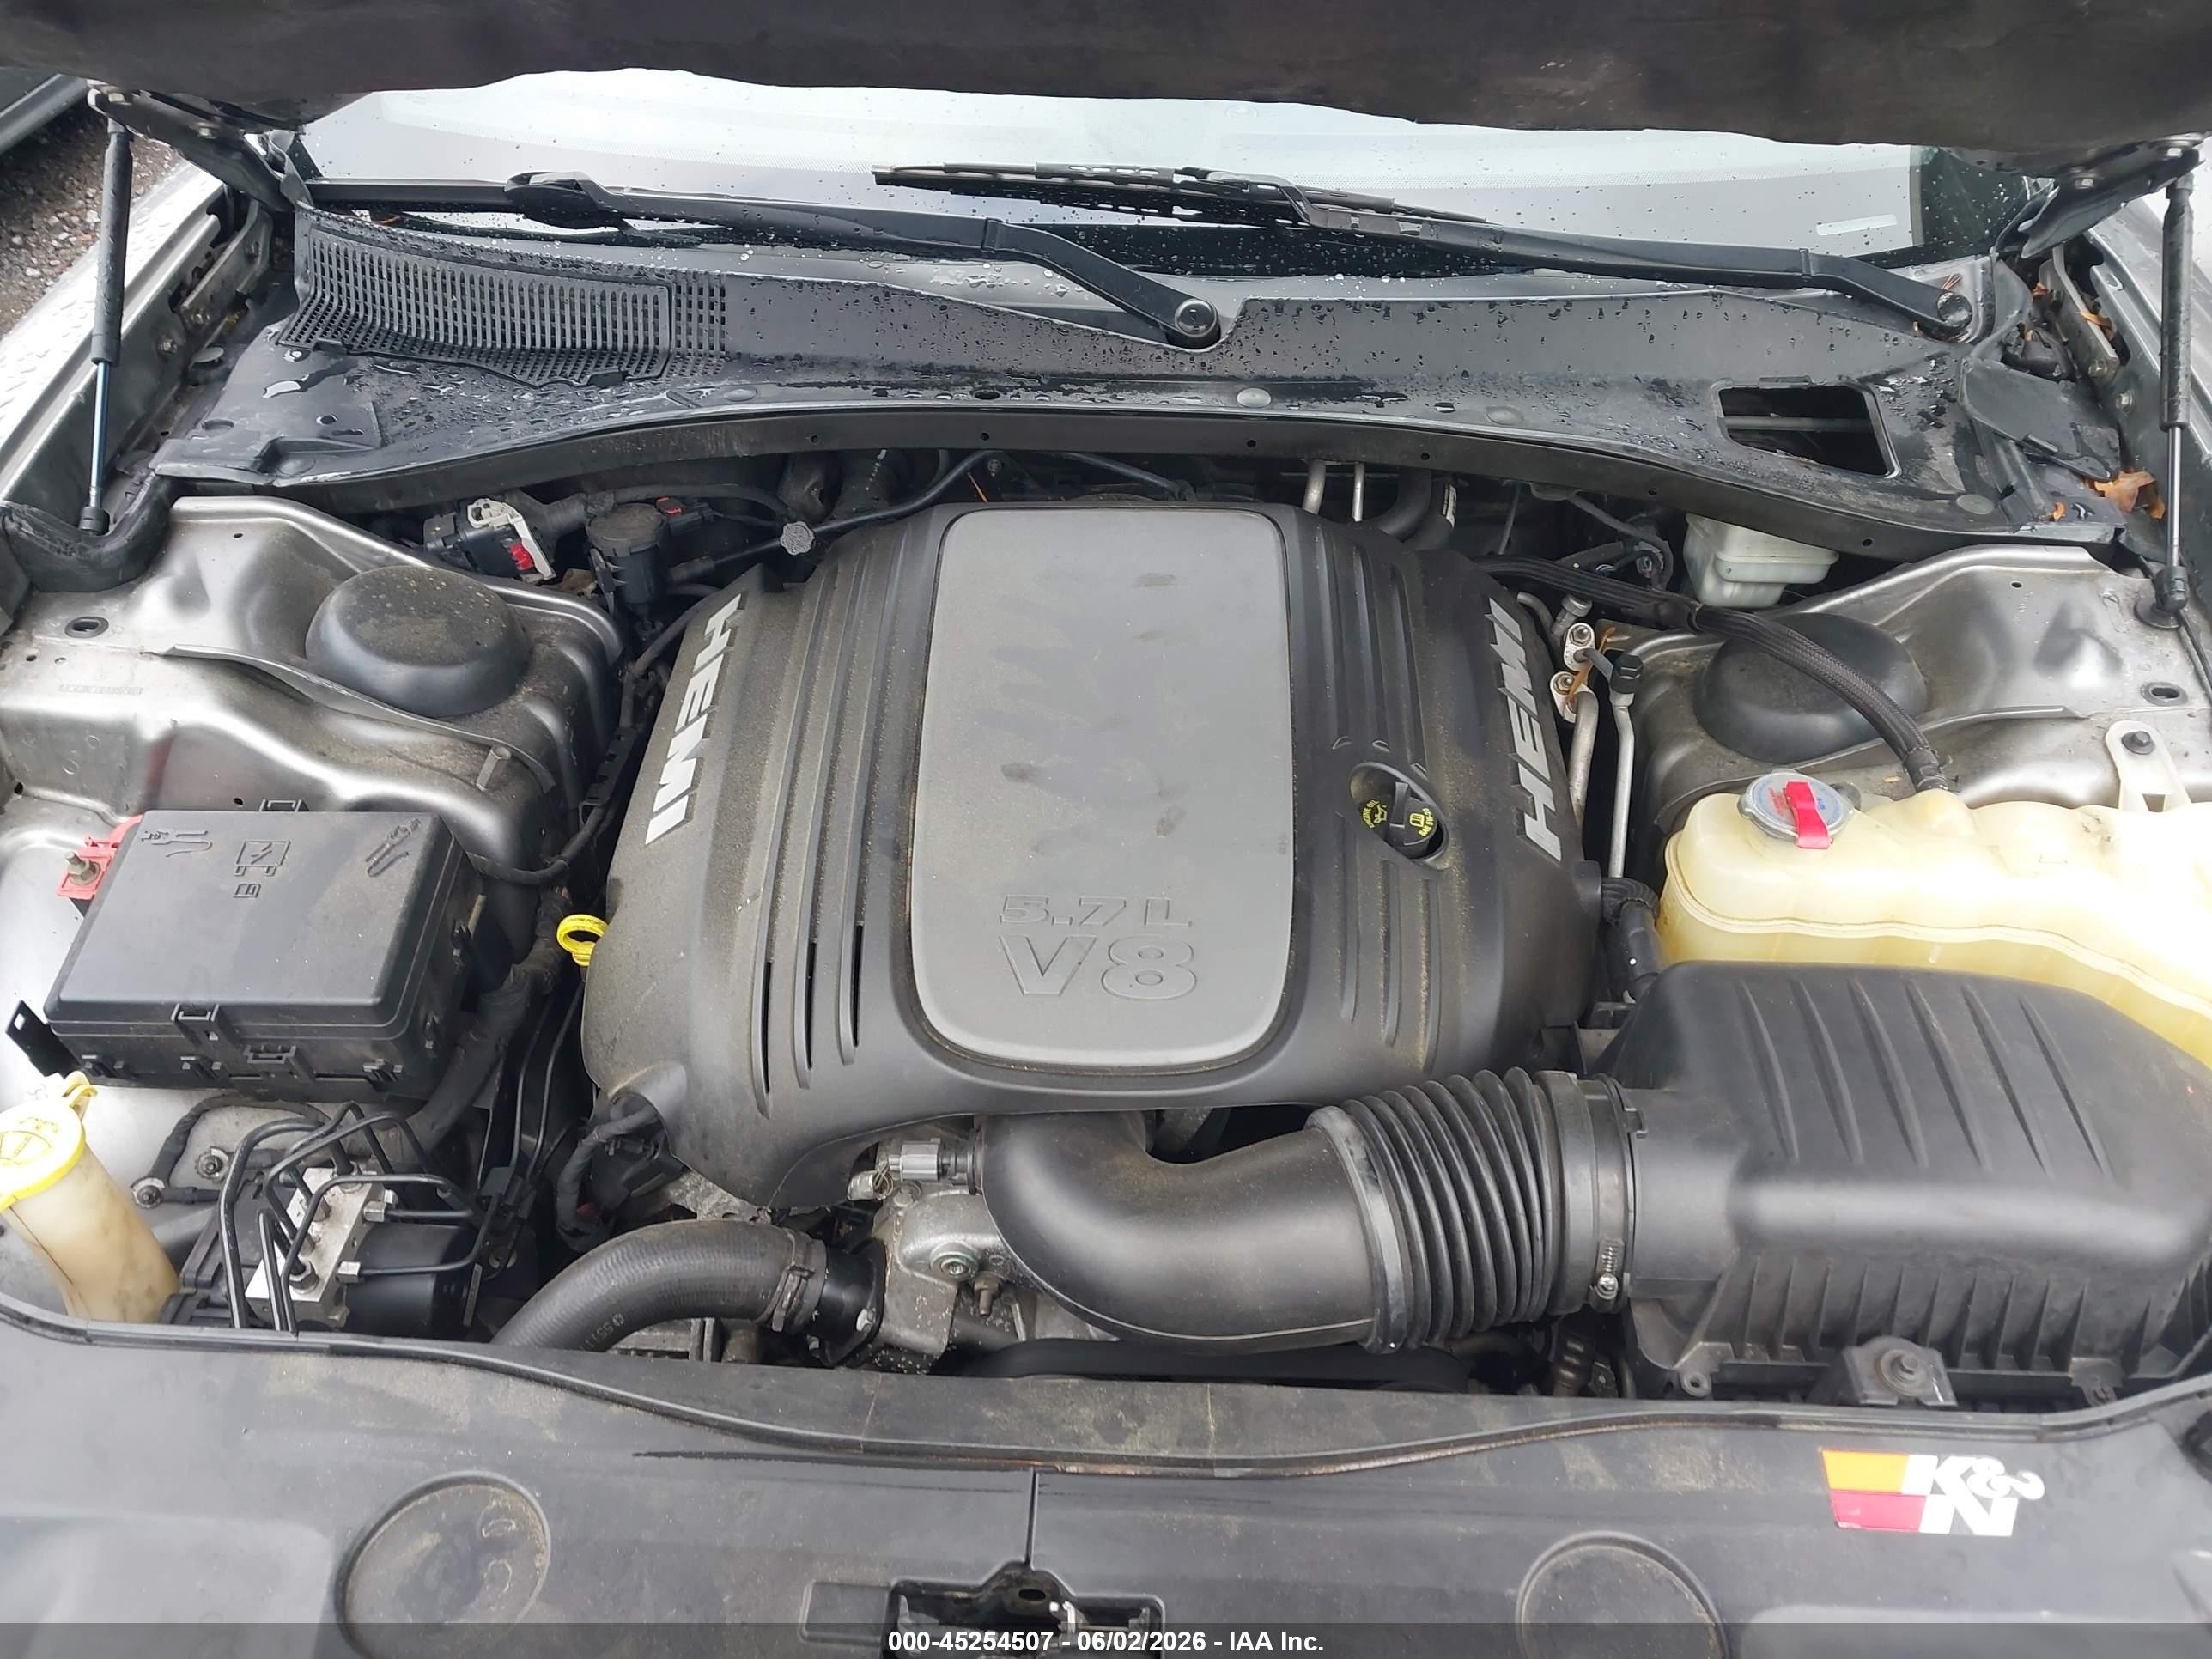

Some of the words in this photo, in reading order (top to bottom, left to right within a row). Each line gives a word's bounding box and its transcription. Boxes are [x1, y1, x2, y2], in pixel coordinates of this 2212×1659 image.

[645, 593, 741, 845] HEMI
[1489, 598, 1562, 862] HEMI
[999, 894, 1127, 927] 5.7
[1143, 896, 1193, 927] L
[999, 933, 1197, 1000] V8
